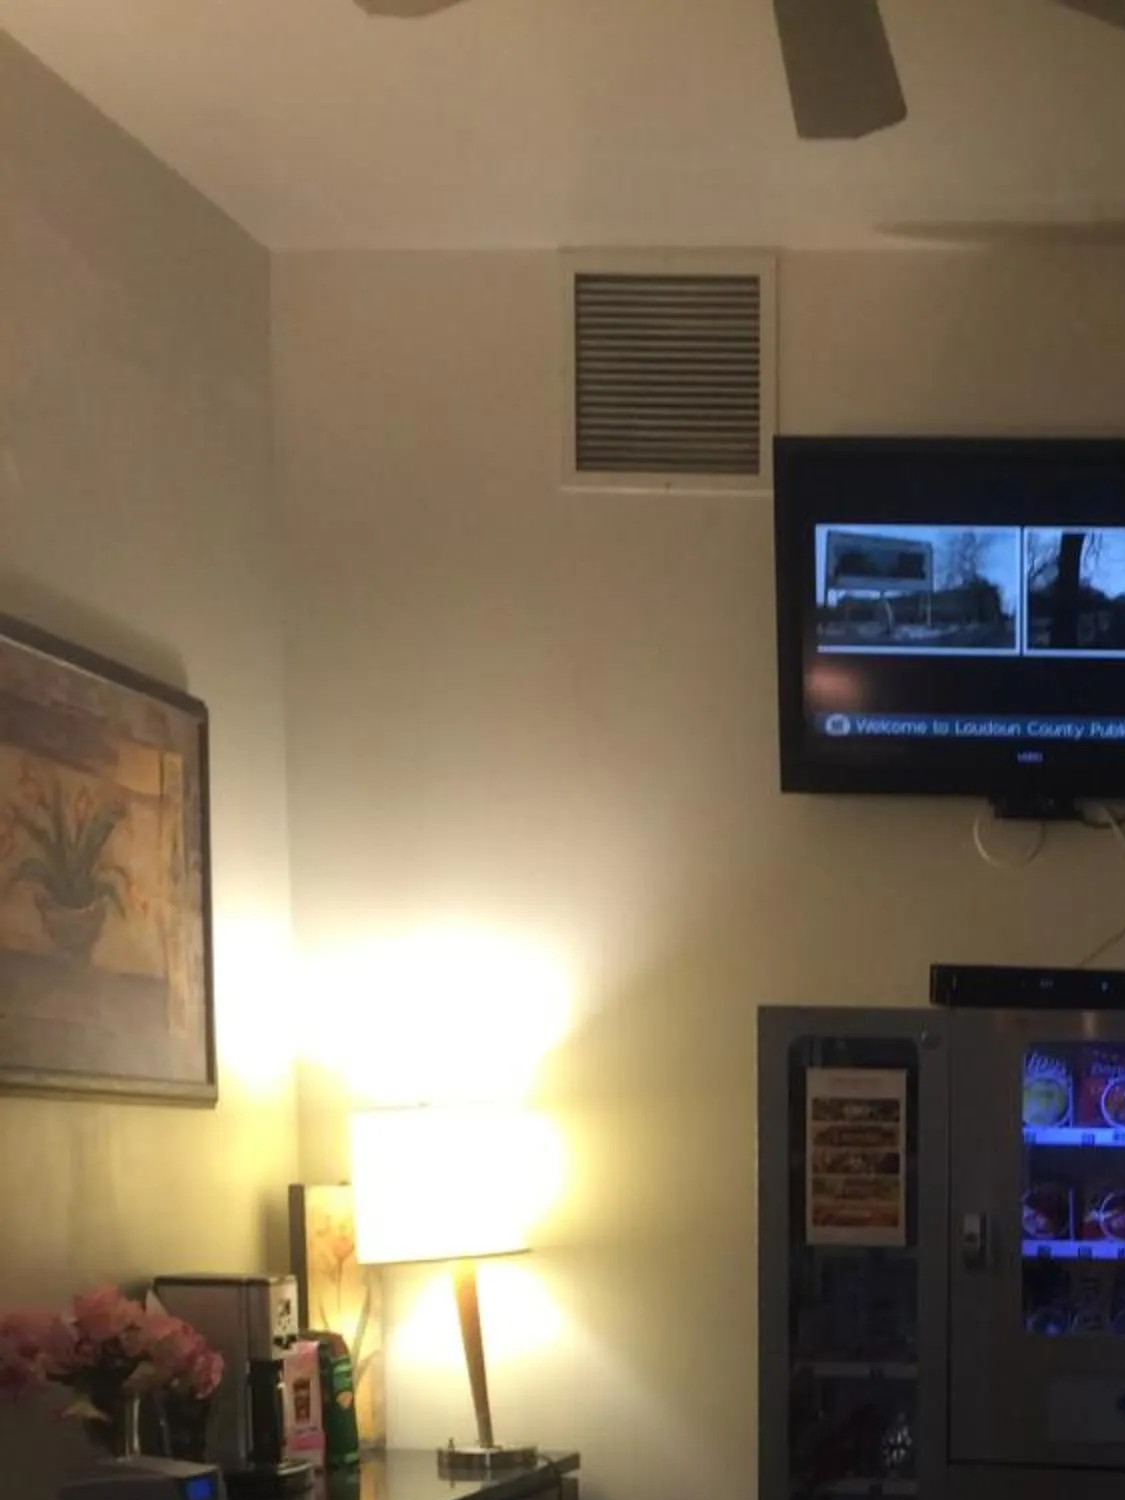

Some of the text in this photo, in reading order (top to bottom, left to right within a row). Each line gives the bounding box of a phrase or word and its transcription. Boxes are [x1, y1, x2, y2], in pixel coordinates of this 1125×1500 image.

[855, 718, 928, 735] Welcome
[933, 719, 949, 735] to
[955, 719, 1021, 736] Loudoun
[1027, 720, 1084, 740] County
